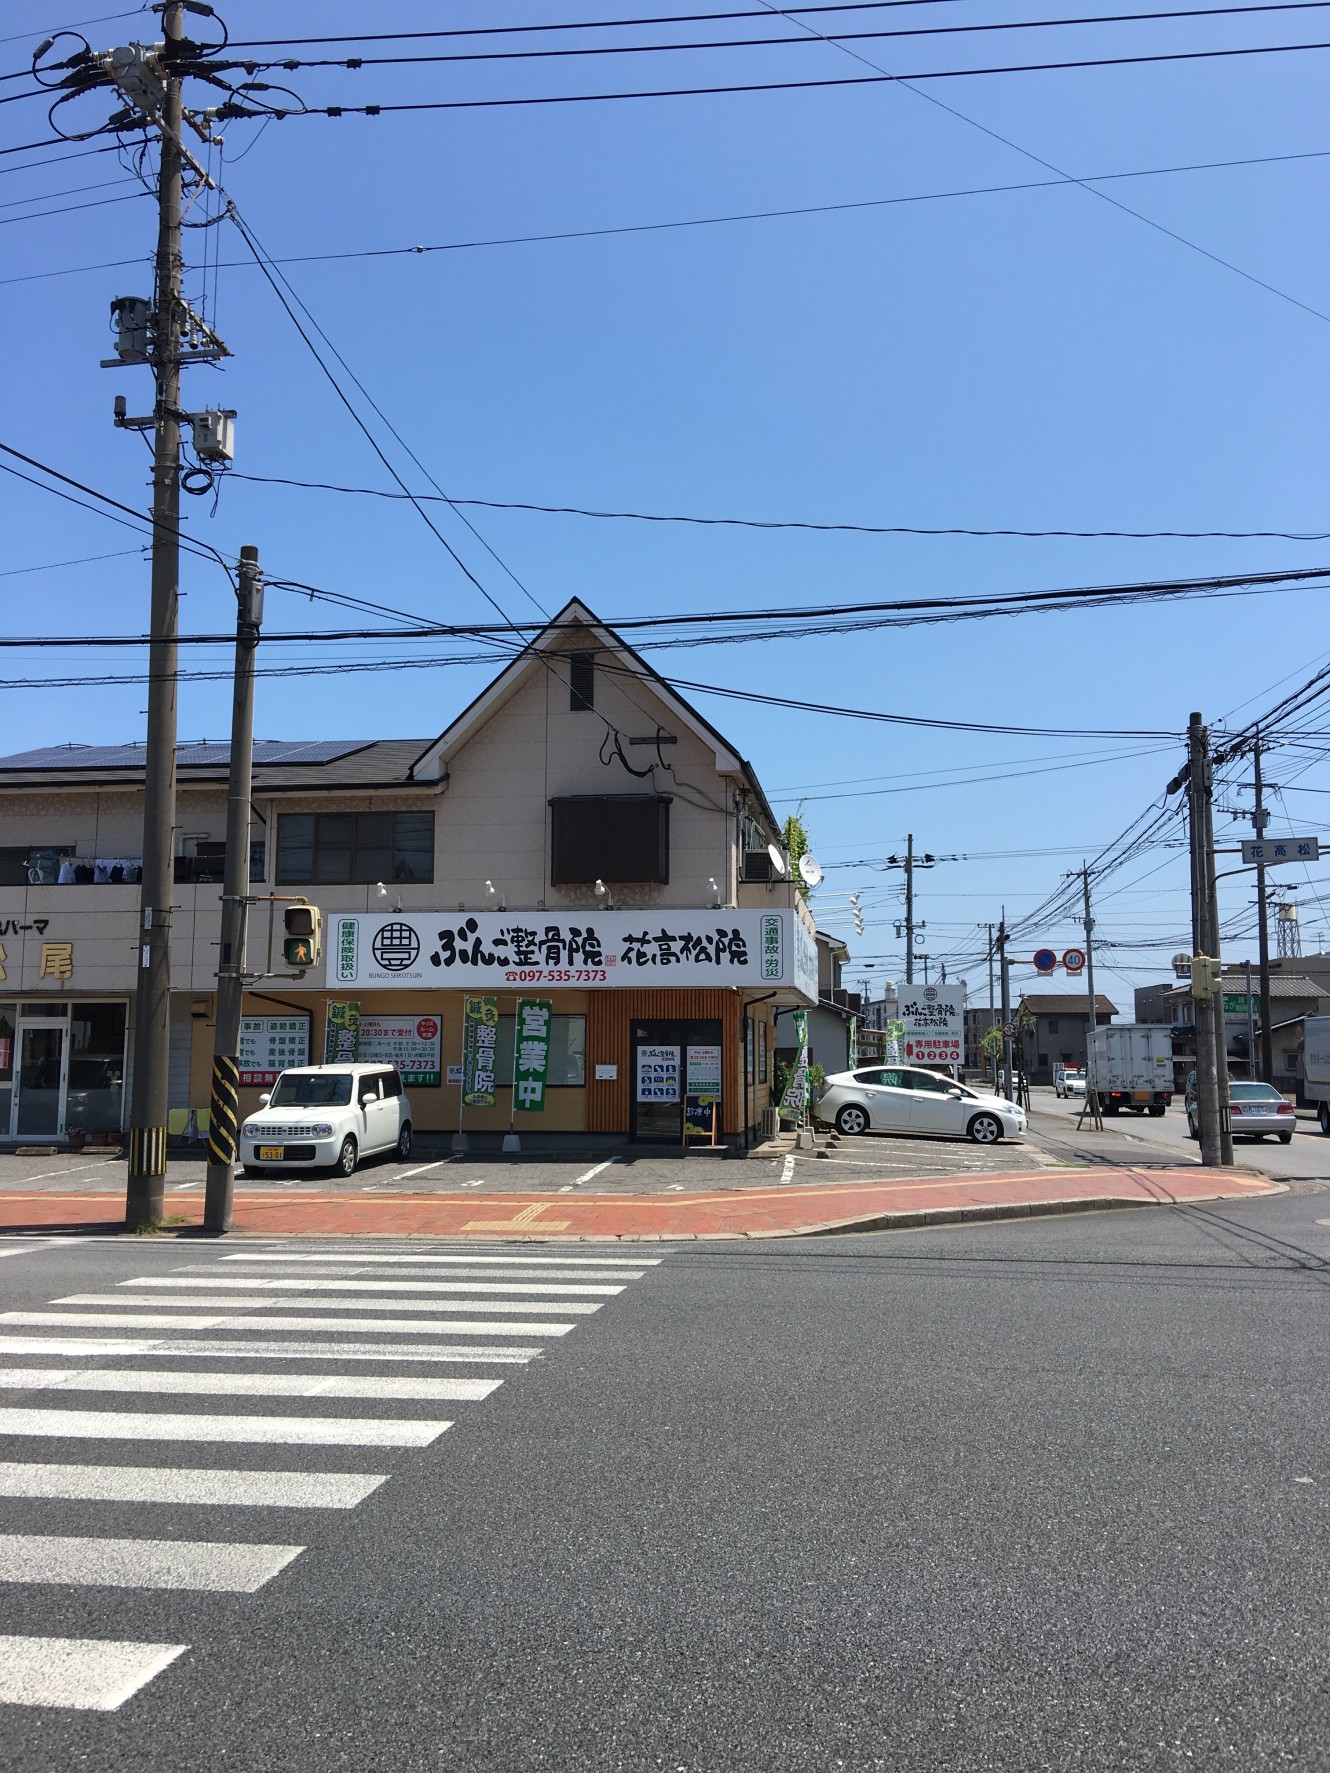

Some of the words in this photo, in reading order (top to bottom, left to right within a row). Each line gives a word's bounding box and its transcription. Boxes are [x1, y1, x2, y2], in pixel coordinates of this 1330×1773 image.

[1251, 843, 1310, 858] 花高松
[0, 919, 49, 936] パーマ
[430, 918, 603, 967] ぶんご整骨院
[621, 928, 748, 967] 花高松院
[764, 918, 779, 977] 交通事故・労災
[341, 921, 355, 979] 健康保険取扱い
[1067, 954, 1080, 965] 40
[519, 970, 607, 982] 097-535-7373
[902, 1001, 956, 1017] ぶんご整骨院
[241, 1022, 261, 1031] 事故
[269, 1022, 306, 1031] 姿勢矯正
[914, 1017, 949, 1027] 花高松院
[361, 1028, 412, 1037] 20:30まで受付
[268, 1036, 306, 1045] 骨盤矯正
[915, 1040, 960, 1049] 専用駐車場
[268, 1047, 305, 1056] 産後骨盤
[518, 1005, 550, 1108] 営業中
[475, 1024, 496, 1093] 整骨院
[242, 1073, 280, 1083] 相談無
